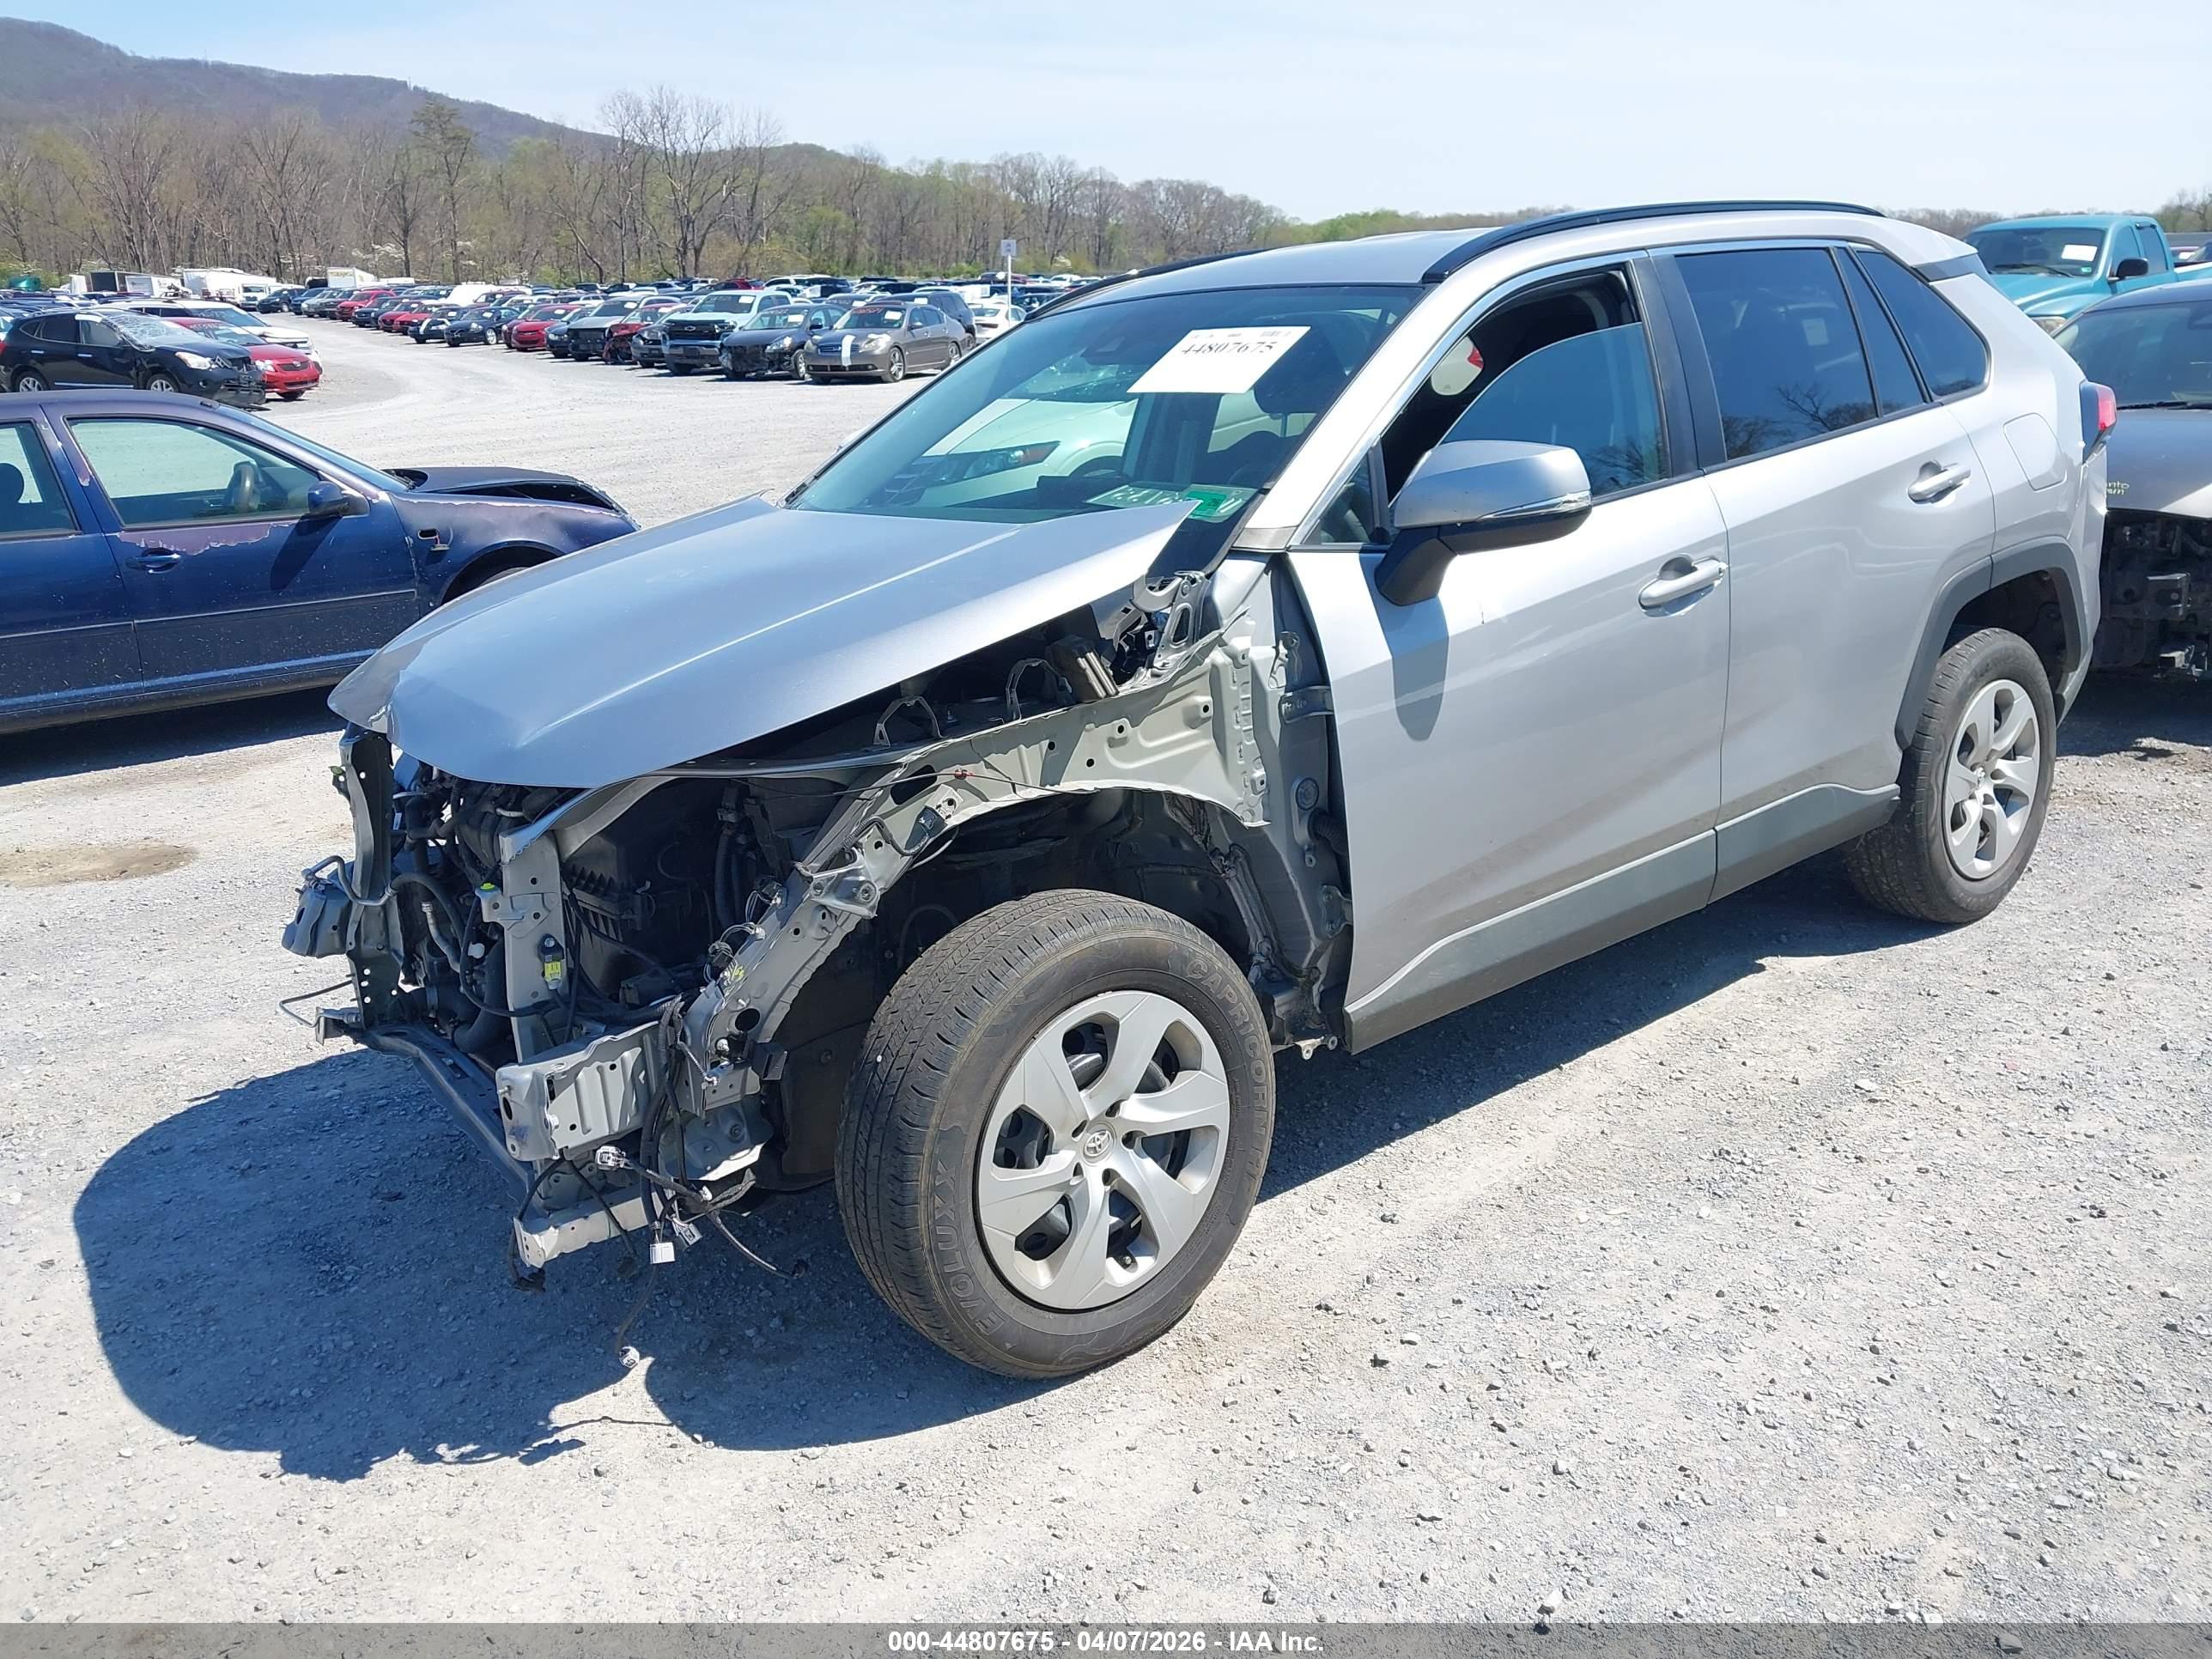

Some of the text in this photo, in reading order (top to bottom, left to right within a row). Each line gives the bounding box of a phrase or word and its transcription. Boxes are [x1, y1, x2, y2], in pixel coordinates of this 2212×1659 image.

[1182, 341, 1279, 355] 44807675
[1186, 957, 1268, 1137] CAPRICORN
[934, 1158, 1006, 1336] EVOLUXX
